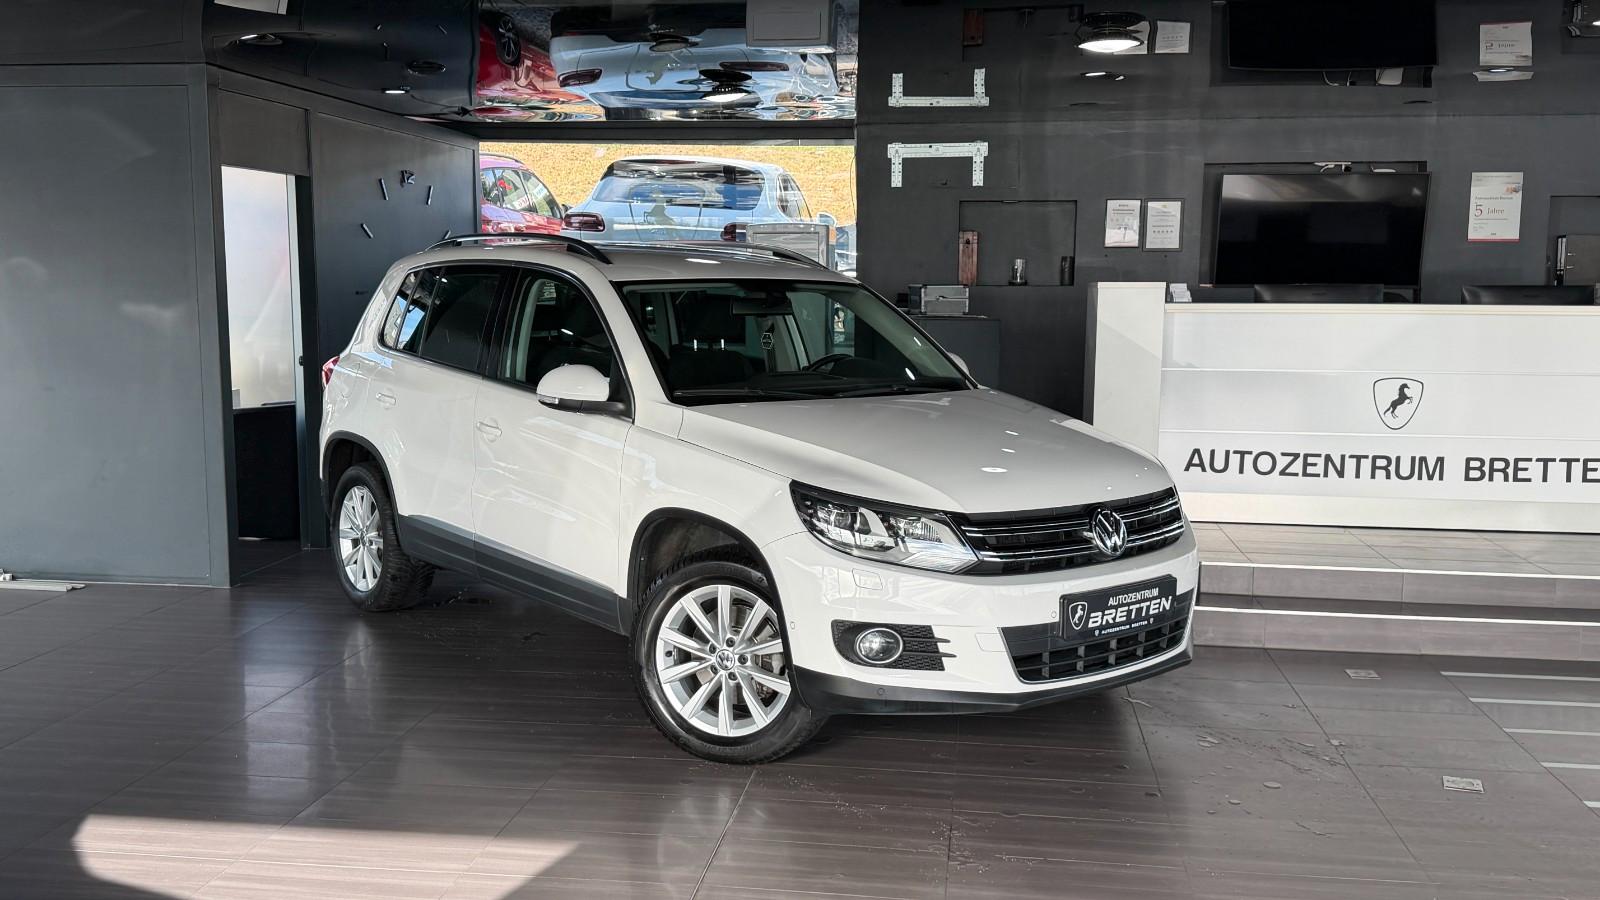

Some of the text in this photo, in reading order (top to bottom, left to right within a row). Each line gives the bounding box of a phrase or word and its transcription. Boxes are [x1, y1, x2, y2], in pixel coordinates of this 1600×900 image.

[1474, 204, 1483, 217] 5
[1184, 448, 1600, 483] AUTOZENTRUM BRETTE
[1108, 587, 1159, 606] AUTOZENTRUM
[1088, 596, 1172, 628] BRETTEN
[1101, 620, 1148, 634] AUTOZENTRUM BRETTEN
